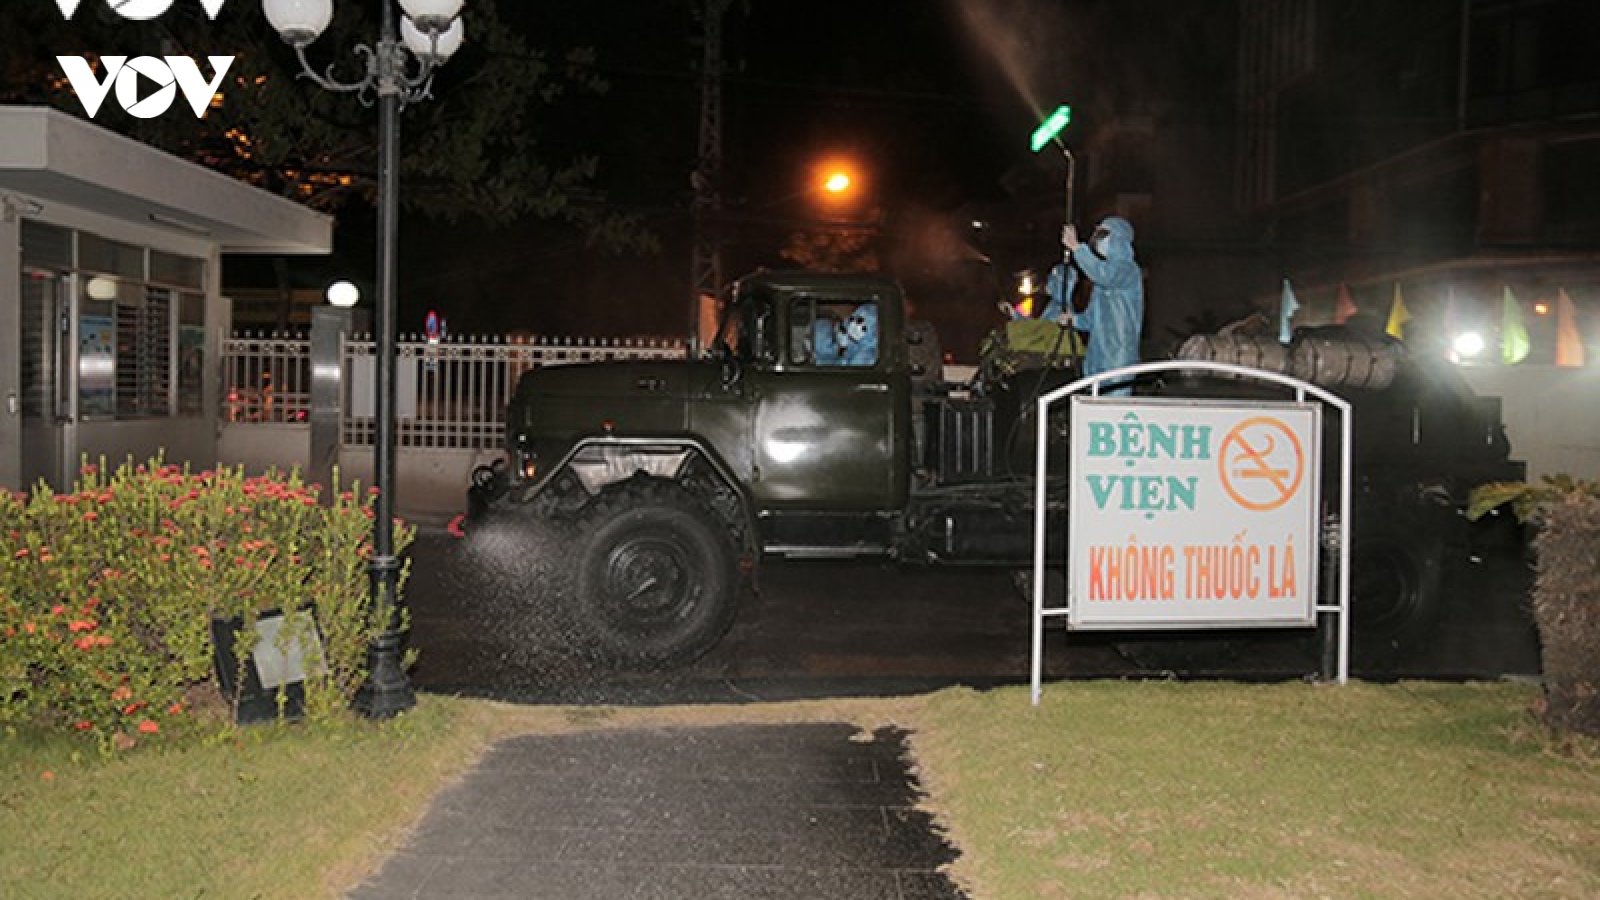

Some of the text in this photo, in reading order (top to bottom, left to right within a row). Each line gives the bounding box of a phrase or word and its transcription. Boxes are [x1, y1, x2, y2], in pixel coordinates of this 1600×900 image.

[1087, 411, 1212, 468] BỆNH
[1088, 528, 1297, 602] KHÔNG THUỐC LÁ
